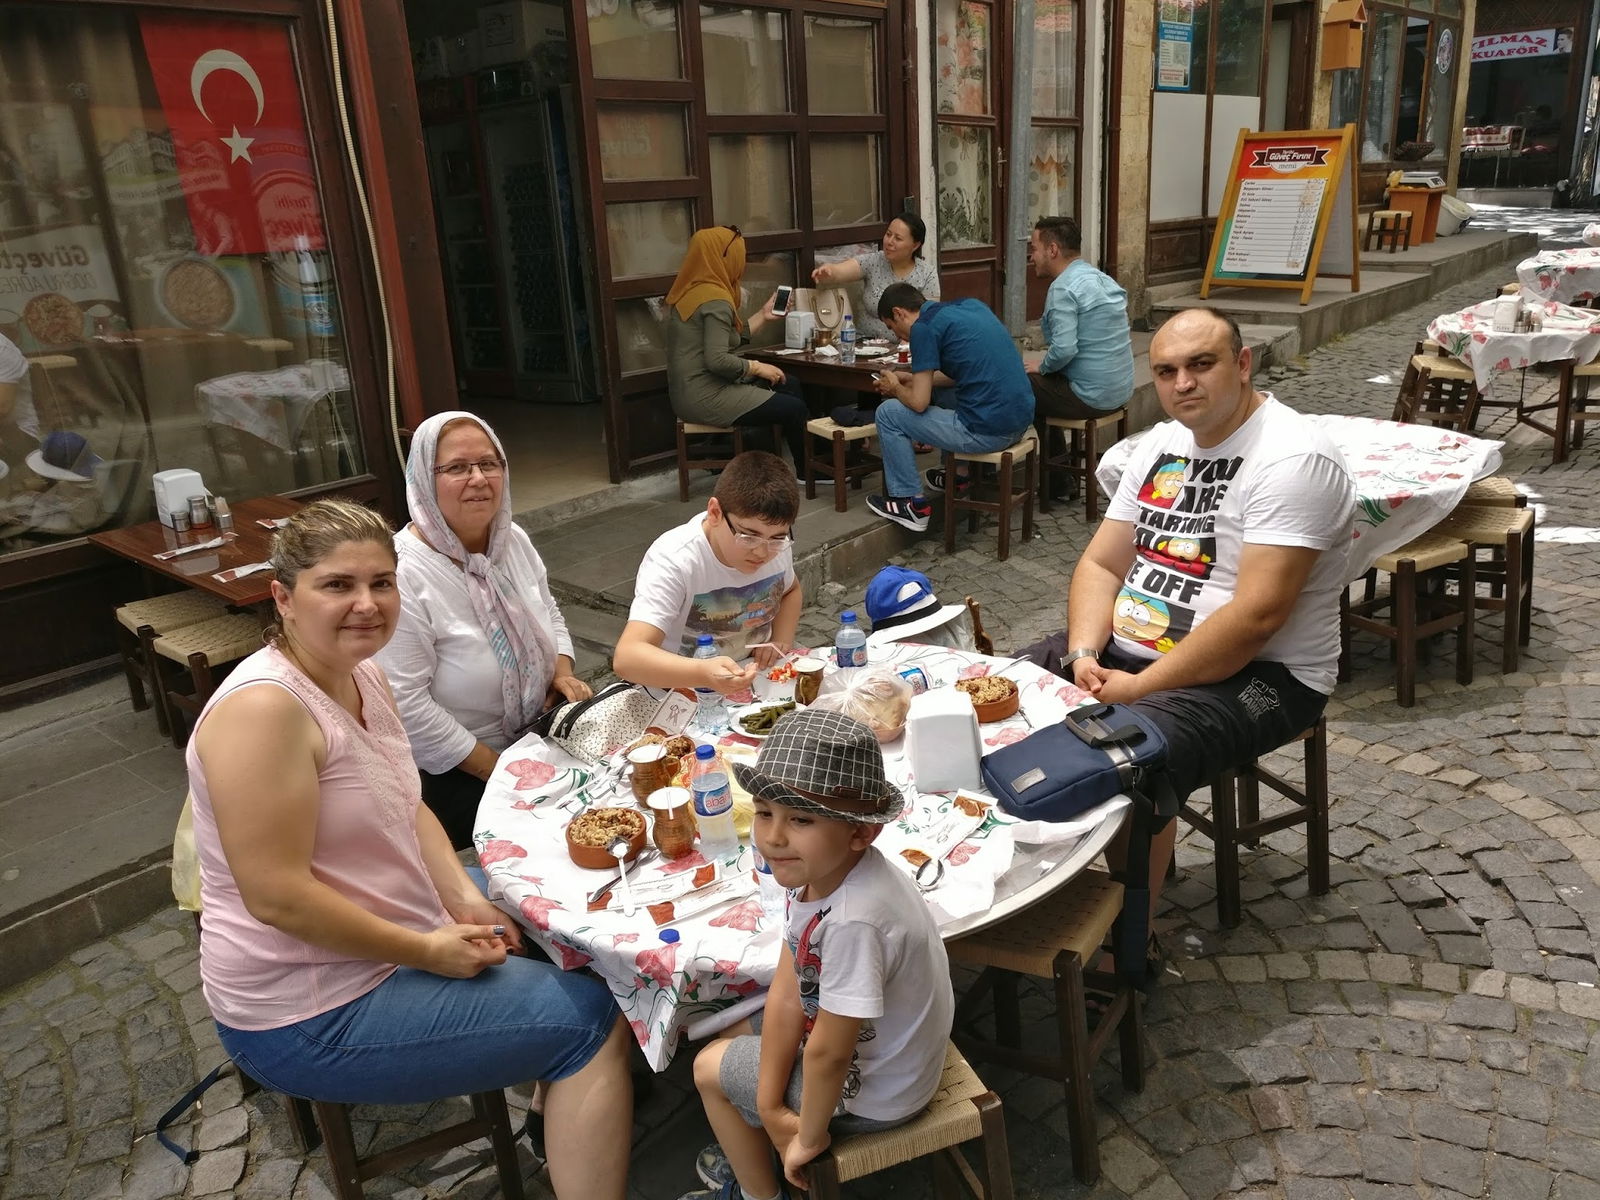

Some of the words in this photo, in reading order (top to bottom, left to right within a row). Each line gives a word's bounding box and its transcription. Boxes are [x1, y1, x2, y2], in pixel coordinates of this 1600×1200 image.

[1472, 46, 1539, 59] KUAFÖR
[1269, 152, 1290, 161] Güveç
[1188, 456, 1244, 483] YOU
[1175, 484, 1228, 513] ARE
[1138, 505, 1215, 534] TARTING
[1127, 561, 1145, 584] E
[1142, 568, 1204, 605] OFF
